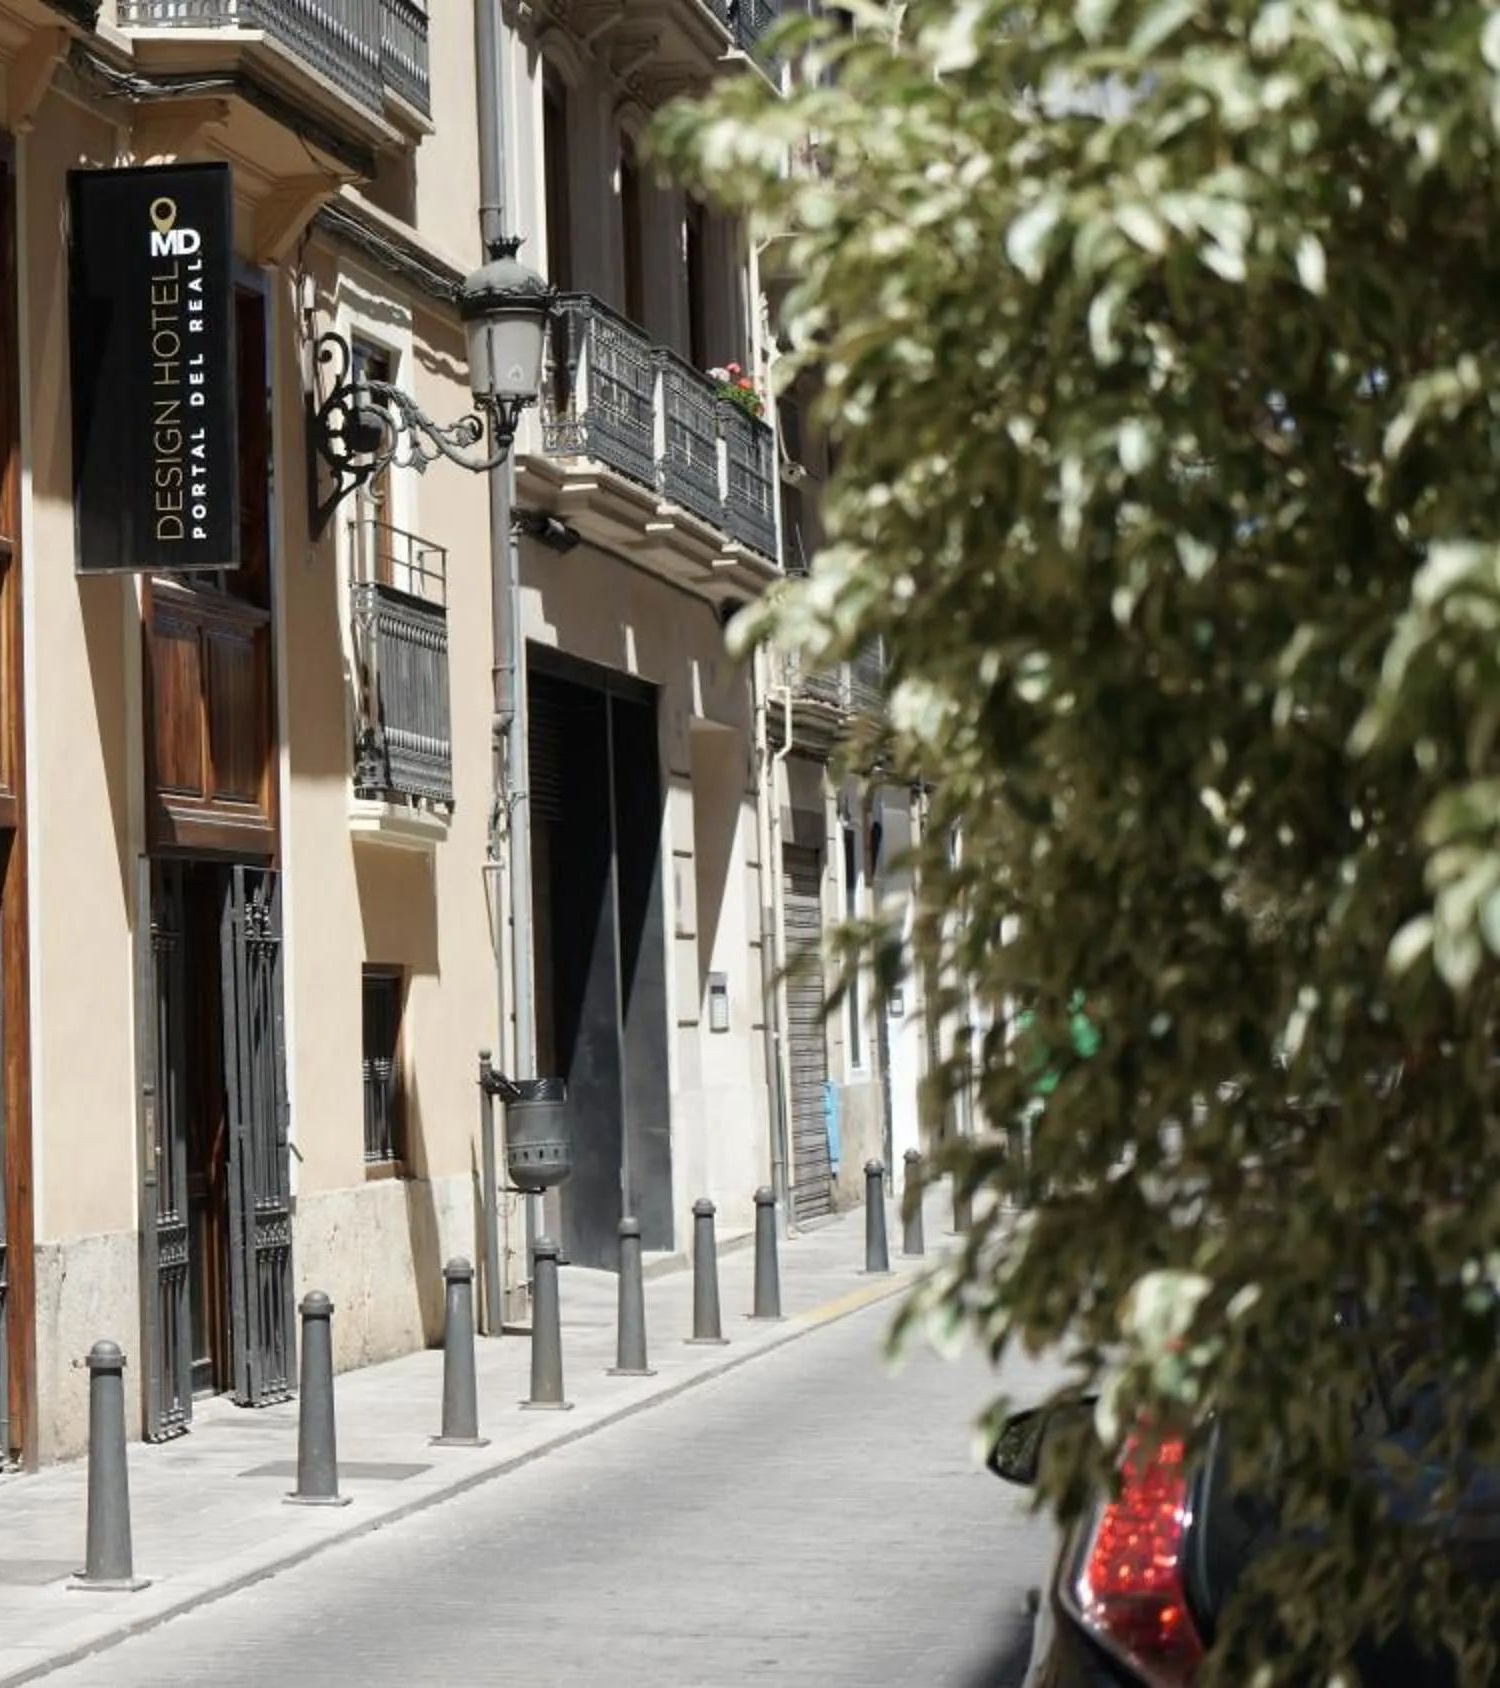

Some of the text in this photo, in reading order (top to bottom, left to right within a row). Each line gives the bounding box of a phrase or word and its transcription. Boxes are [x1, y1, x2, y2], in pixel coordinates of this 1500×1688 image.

[150, 227, 201, 257] MD
[151, 259, 184, 540] DESIGN HOTEL
[187, 259, 207, 540] PORTAL DEL REAL
